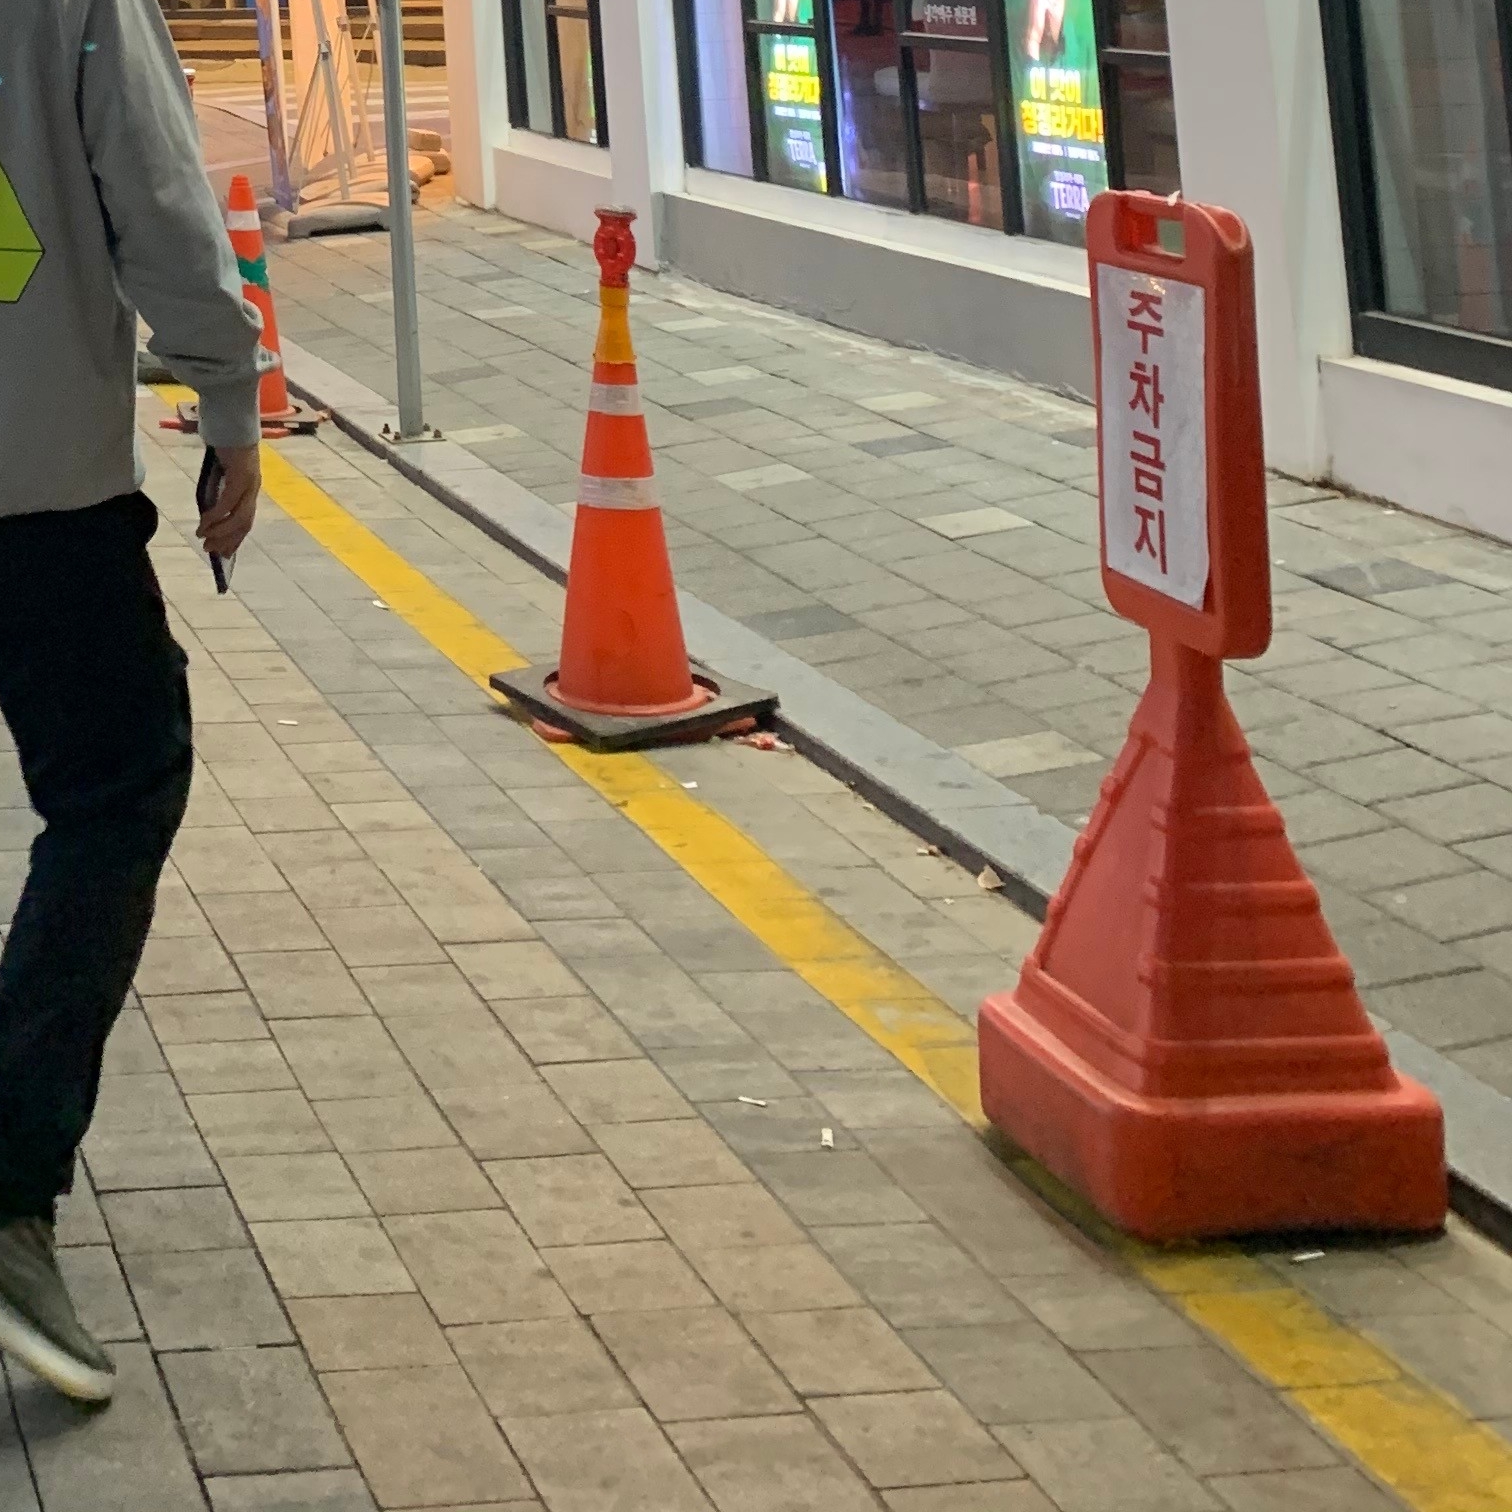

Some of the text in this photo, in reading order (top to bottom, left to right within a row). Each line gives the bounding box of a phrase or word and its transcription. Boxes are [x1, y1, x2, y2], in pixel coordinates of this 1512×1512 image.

[1029, 66, 1047, 101] 이
[1049, 180, 1091, 213] TERRA
[1126, 289, 1169, 576] 주차금지
